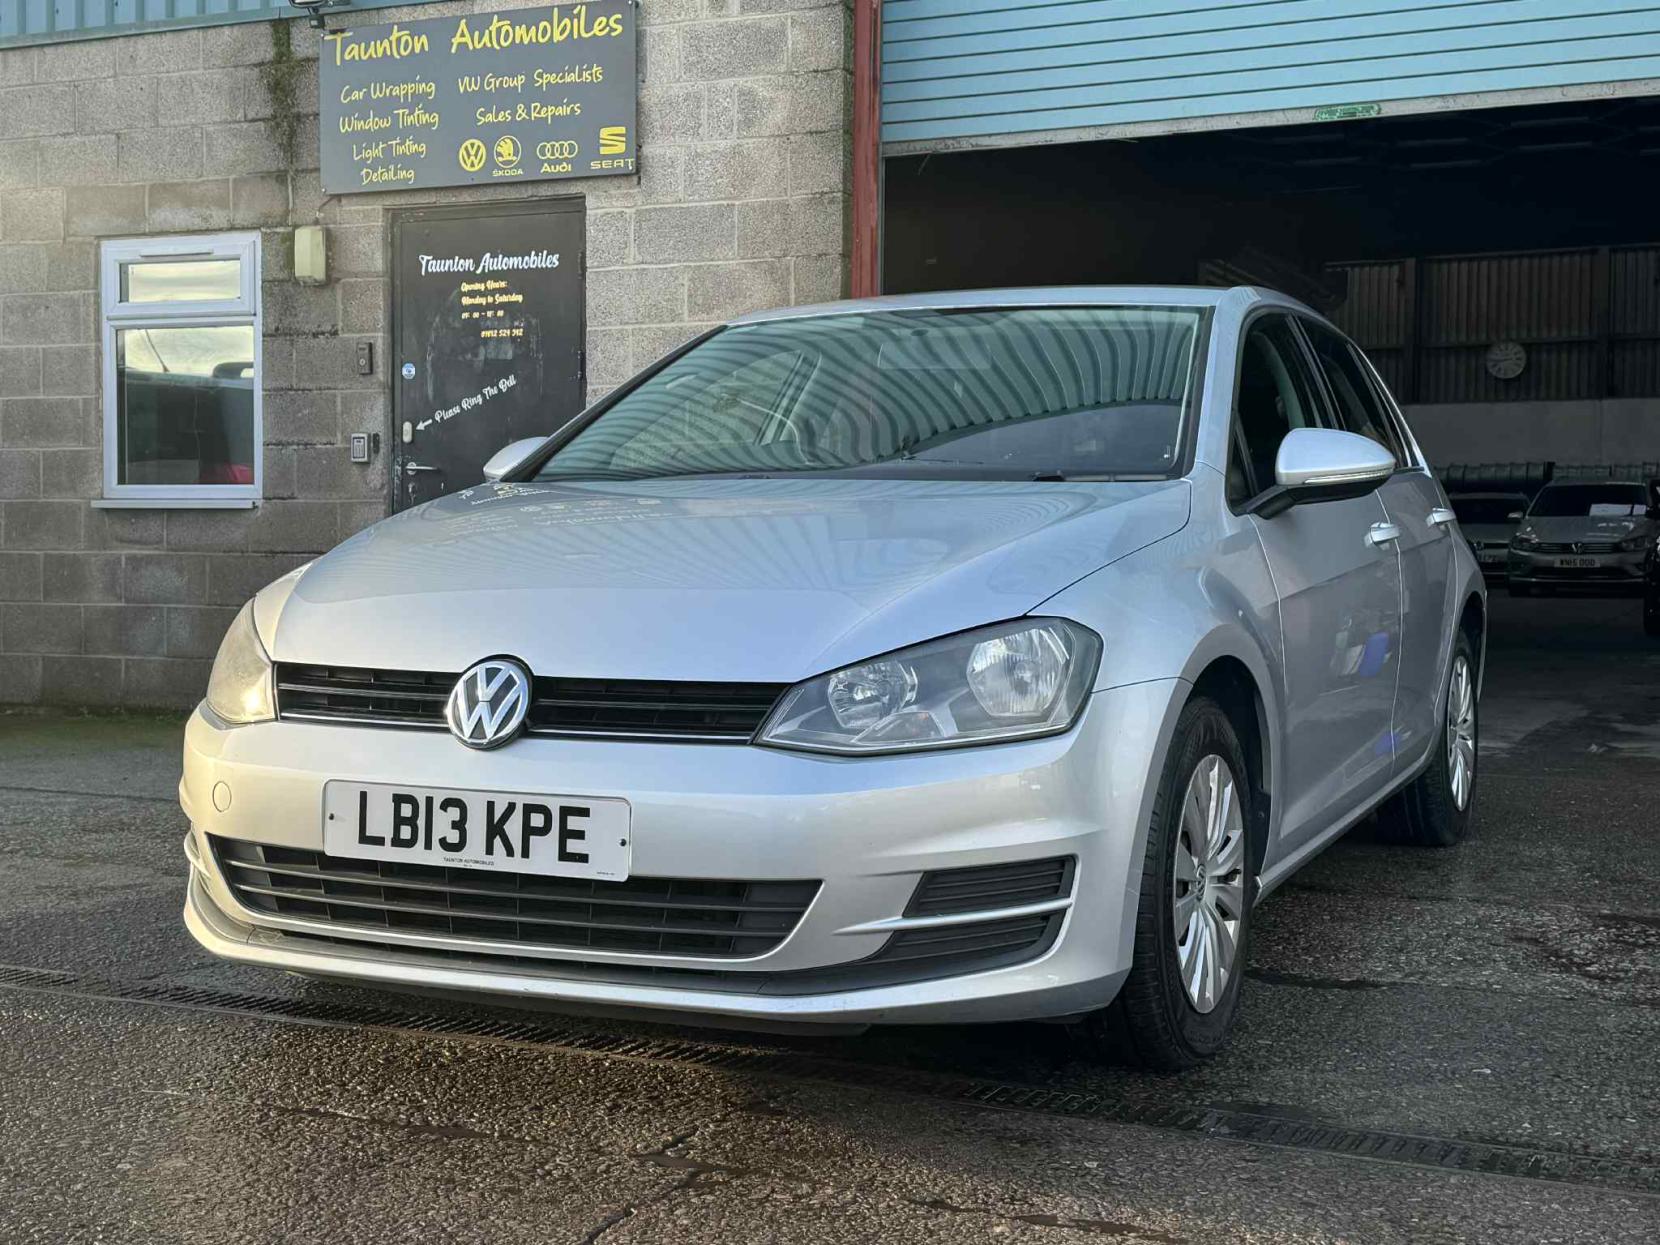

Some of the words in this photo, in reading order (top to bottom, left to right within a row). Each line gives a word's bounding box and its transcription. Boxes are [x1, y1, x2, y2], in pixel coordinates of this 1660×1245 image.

[324, 25, 429, 65] Taunton
[451, 5, 623, 54] Automobiles
[341, 85, 367, 103] Car
[370, 75, 436, 103] Wrapping
[458, 76, 480, 93] VW
[484, 70, 526, 92] Group
[534, 64, 603, 90] Specialists
[340, 109, 391, 133] Window
[393, 103, 439, 130] Tinting
[476, 107, 511, 125] Sales
[515, 105, 528, 119] &
[531, 99, 582, 123] Repairs
[353, 141, 387, 164] Light
[387, 135, 426, 158] Tinting
[361, 164, 415, 185] Detailing
[540, 162, 573, 174] Audi
[590, 158, 635, 170] SEAT
[419, 254, 475, 276] Taunton
[475, 250, 560, 274] Automobiles
[461, 282, 485, 293] Opening
[461, 295, 486, 306] Monday
[487, 295, 494, 303] to
[495, 293, 523, 304] Saturday
[435, 405, 460, 423] Please
[461, 394, 483, 411] Ring
[482, 386, 498, 400] The
[498, 374, 517, 392] Bell
[358, 790, 468, 853] LB13
[485, 800, 591, 864] KPE
